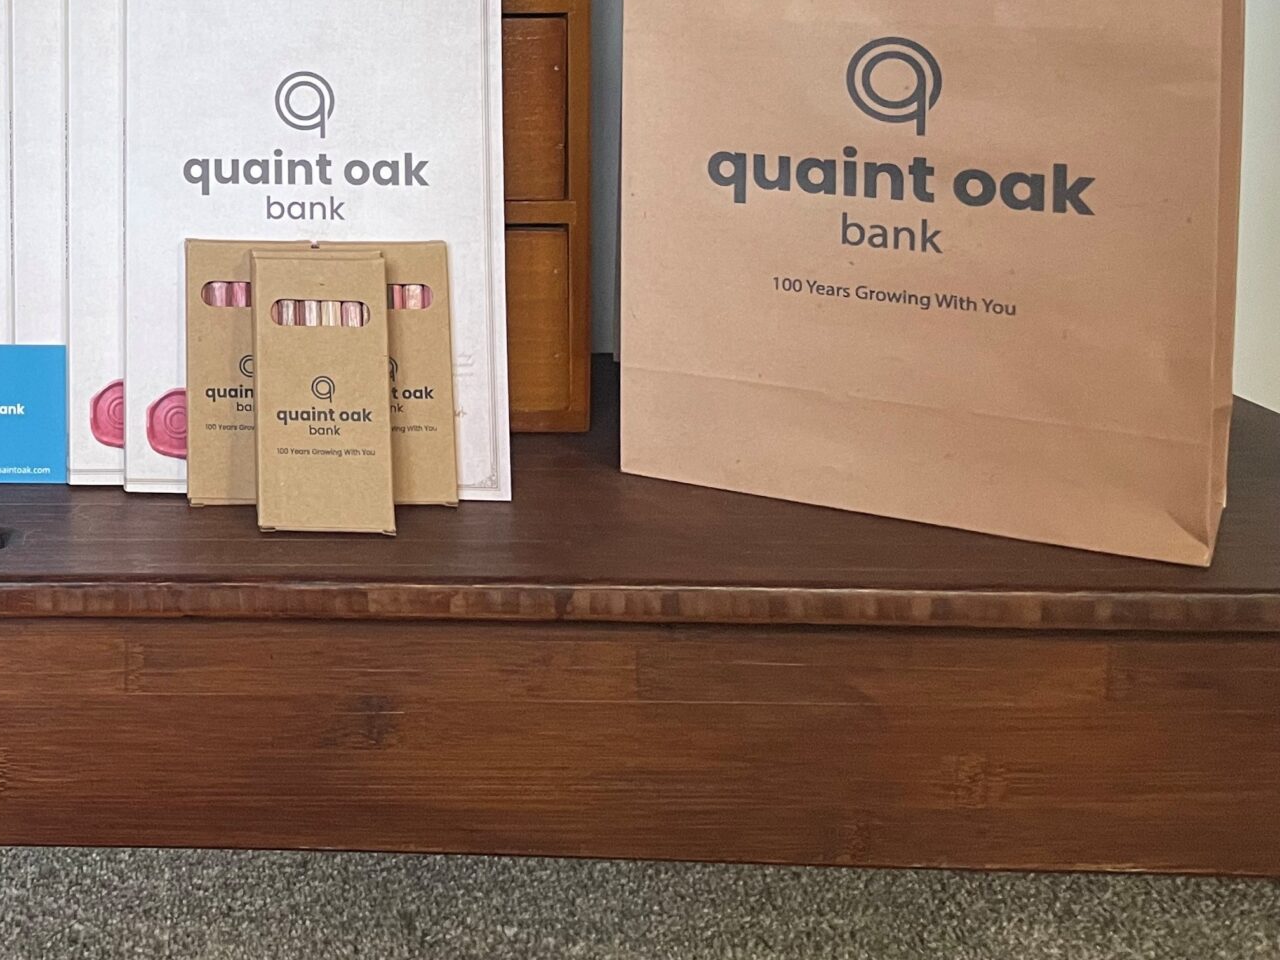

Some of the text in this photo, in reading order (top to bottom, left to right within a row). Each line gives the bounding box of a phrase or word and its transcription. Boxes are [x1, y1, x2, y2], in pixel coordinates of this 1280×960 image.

[183, 149, 430, 195] quaint oak
[707, 146, 1096, 216] quaint oak
[266, 195, 345, 220] bank
[841, 212, 943, 254] bank
[772, 276, 1016, 316] 100 Years Growing With You
[206, 384, 253, 402] quain
[402, 386, 434, 399] oak
[236, 402, 252, 411] ba
[277, 406, 372, 425] quaint oak
[390, 403, 404, 413] nk
[309, 425, 340, 435] bank
[312, 448, 342, 457] Growing
